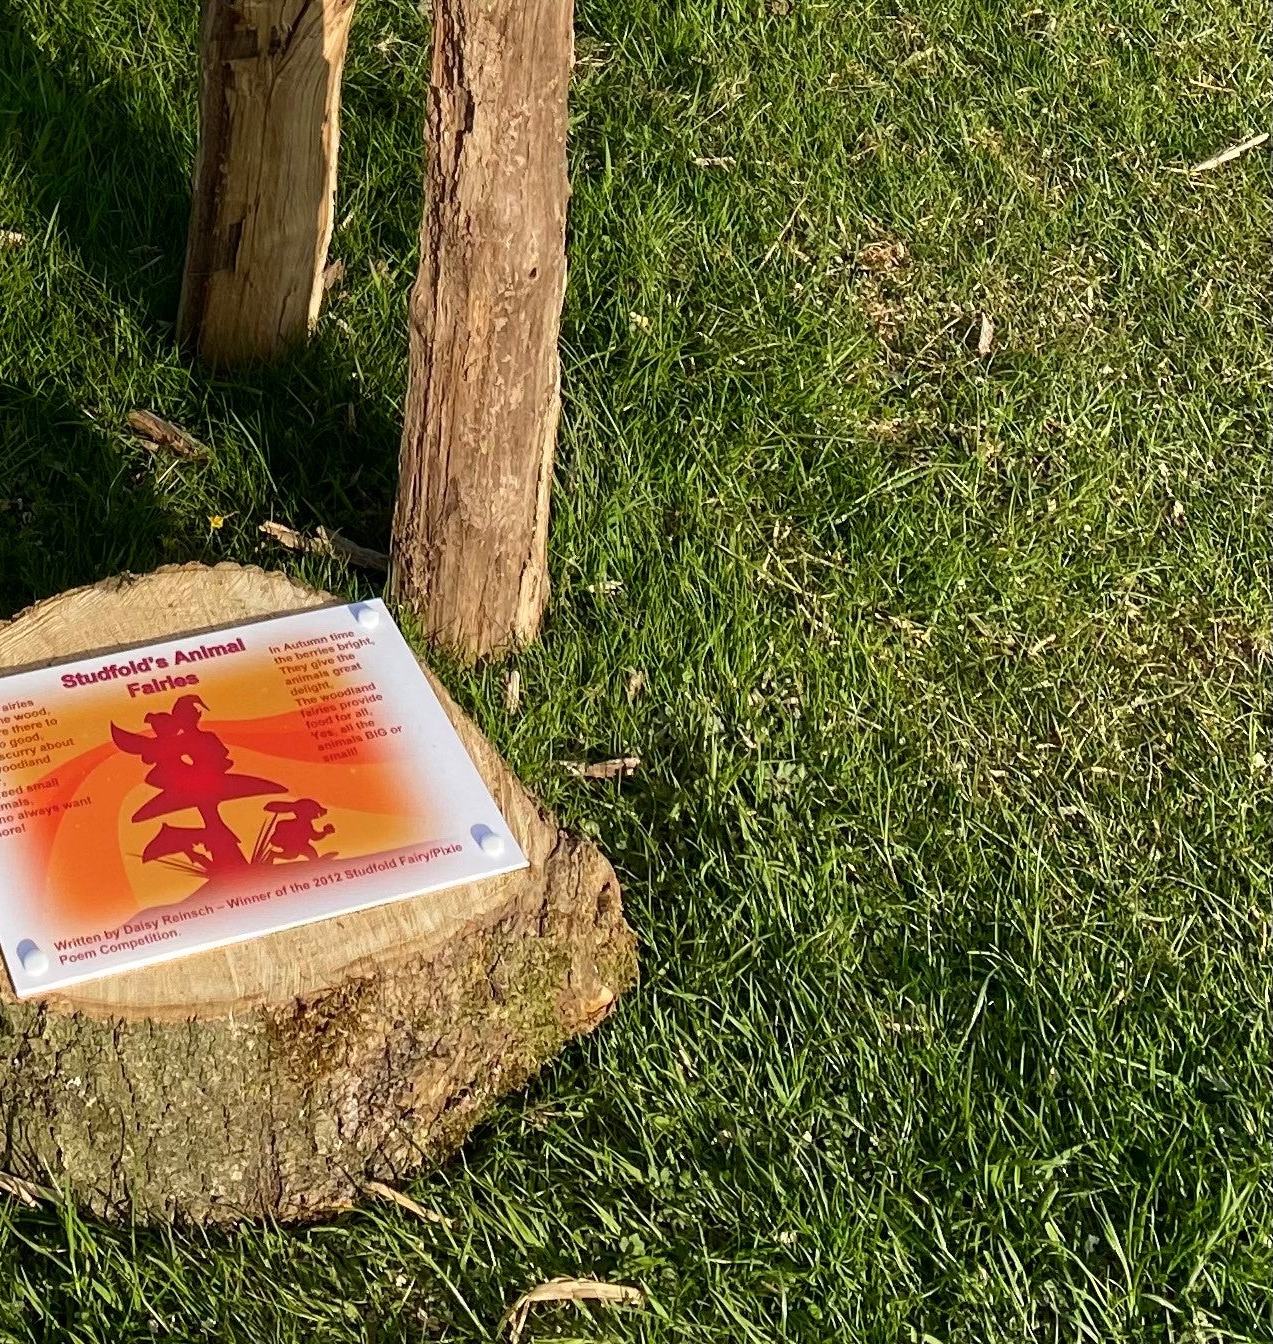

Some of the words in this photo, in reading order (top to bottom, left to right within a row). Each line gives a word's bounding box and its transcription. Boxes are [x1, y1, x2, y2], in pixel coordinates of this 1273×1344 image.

[269, 646, 281, 654] In
[284, 636, 328, 651] Autumn
[330, 631, 354, 641] time
[61, 657, 169, 688] Studfold's
[174, 638, 246, 665] Animal
[274, 654, 292, 664] the
[296, 646, 335, 660] berries
[280, 663, 308, 675] They
[311, 658, 335, 670] give
[337, 653, 356, 663] the
[126, 673, 200, 697] Fairies
[286, 670, 330, 685] animals
[332, 662, 362, 676] great
[294, 697, 317, 707] The
[321, 682, 376, 702] woodland
[300, 704, 337, 718] fairies
[340, 694, 382, 710] provide
[12, 722, 43, 734] there
[46, 718, 58, 726] to
[306, 716, 333, 728] food
[336, 712, 352, 722] for
[340, 725, 354, 734] all
[356, 720, 375, 730] the
[40, 738, 75, 752] about
[318, 734, 363, 751] animals
[366, 728, 387, 740] BIG
[390, 725, 402, 734] or
[26, 778, 58, 792] small
[17, 804, 61, 820] always
[62, 796, 92, 808] want
[54, 934, 101, 951] Written
[104, 928, 120, 940] by
[124, 916, 159, 935] Daisy
[162, 905, 214, 926] Reinsch
[226, 887, 271, 909] Winner
[276, 885, 288, 897] of
[290, 881, 311, 894] the
[313, 872, 343, 888] 2012
[344, 861, 397, 879] Studfold
[400, 843, 463, 866] Fairy/Pixie
[59, 950, 97, 966] Poem
